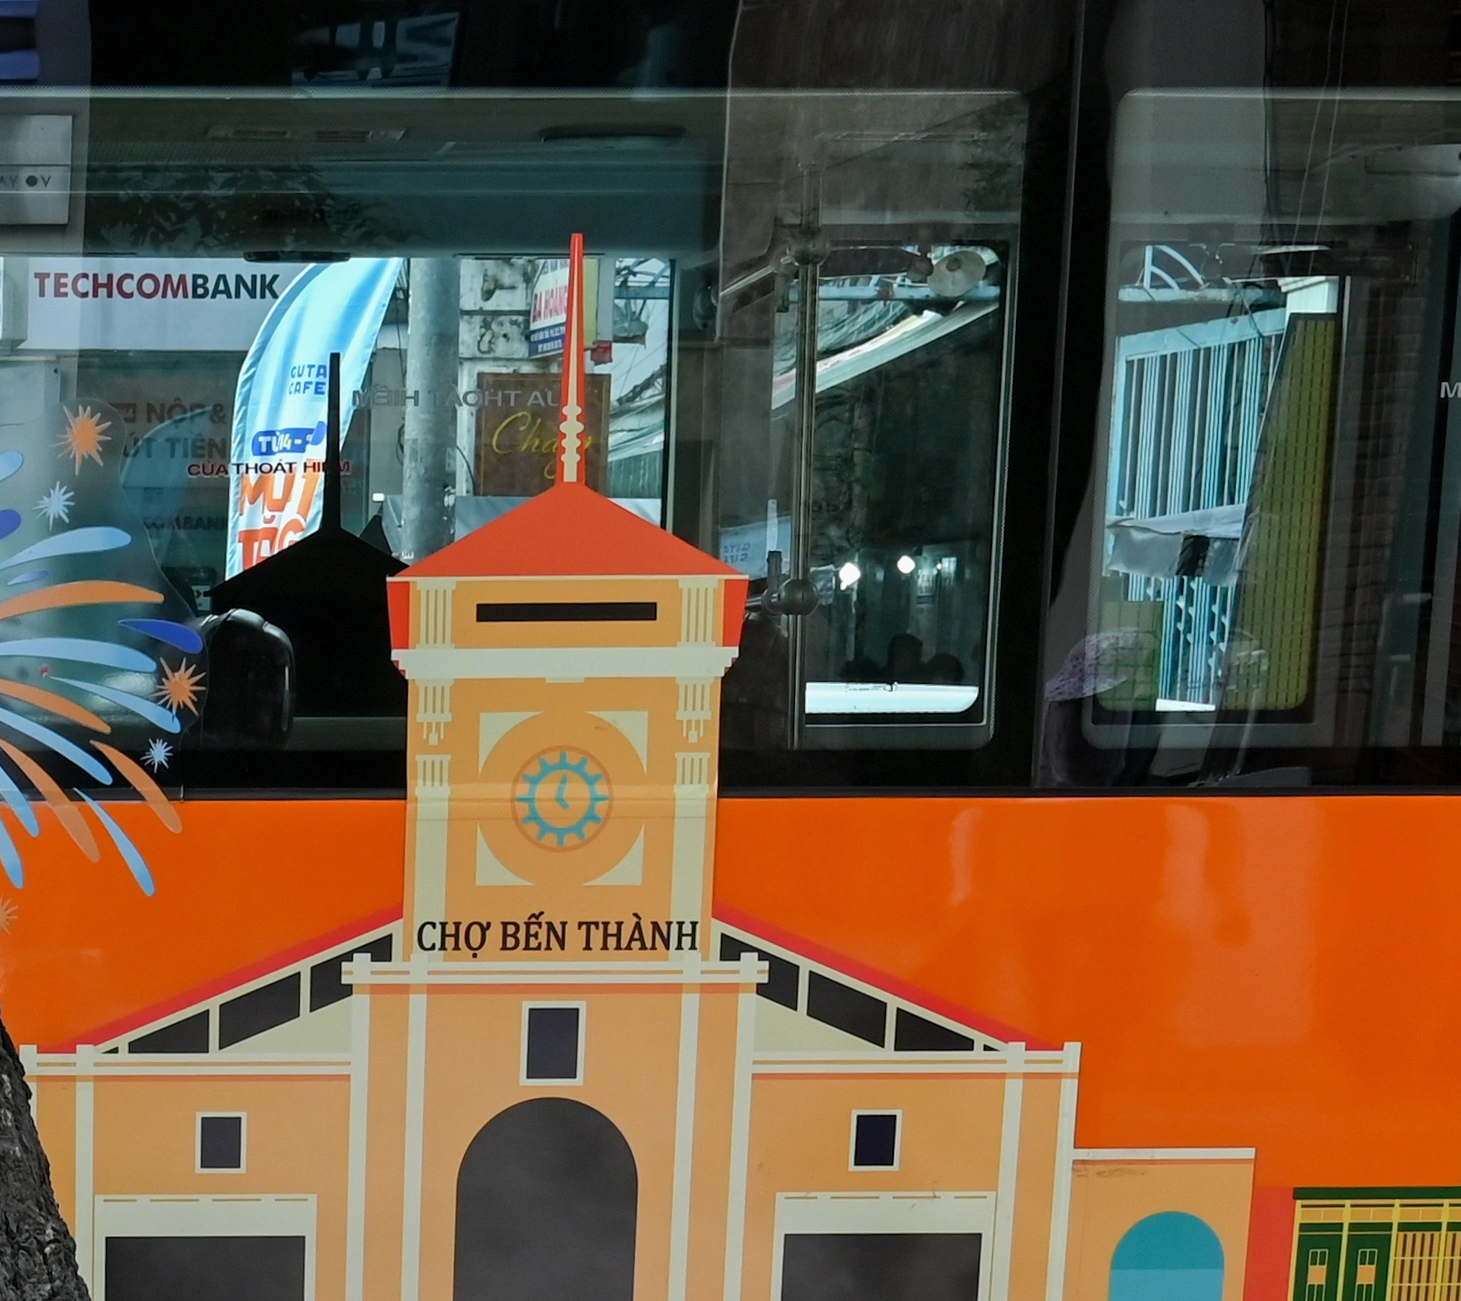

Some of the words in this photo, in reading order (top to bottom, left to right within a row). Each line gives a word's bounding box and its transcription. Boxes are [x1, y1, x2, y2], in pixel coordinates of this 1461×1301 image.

[34, 272, 280, 300] TECHCOMBANK
[290, 364, 327, 379] GUTA
[288, 381, 326, 395] CAFE
[231, 458, 298, 475] THOÁT
[303, 461, 352, 475] HIM
[417, 921, 492, 958] CHỢ
[500, 911, 568, 951] BẾN
[577, 912, 699, 951] THÀNH
